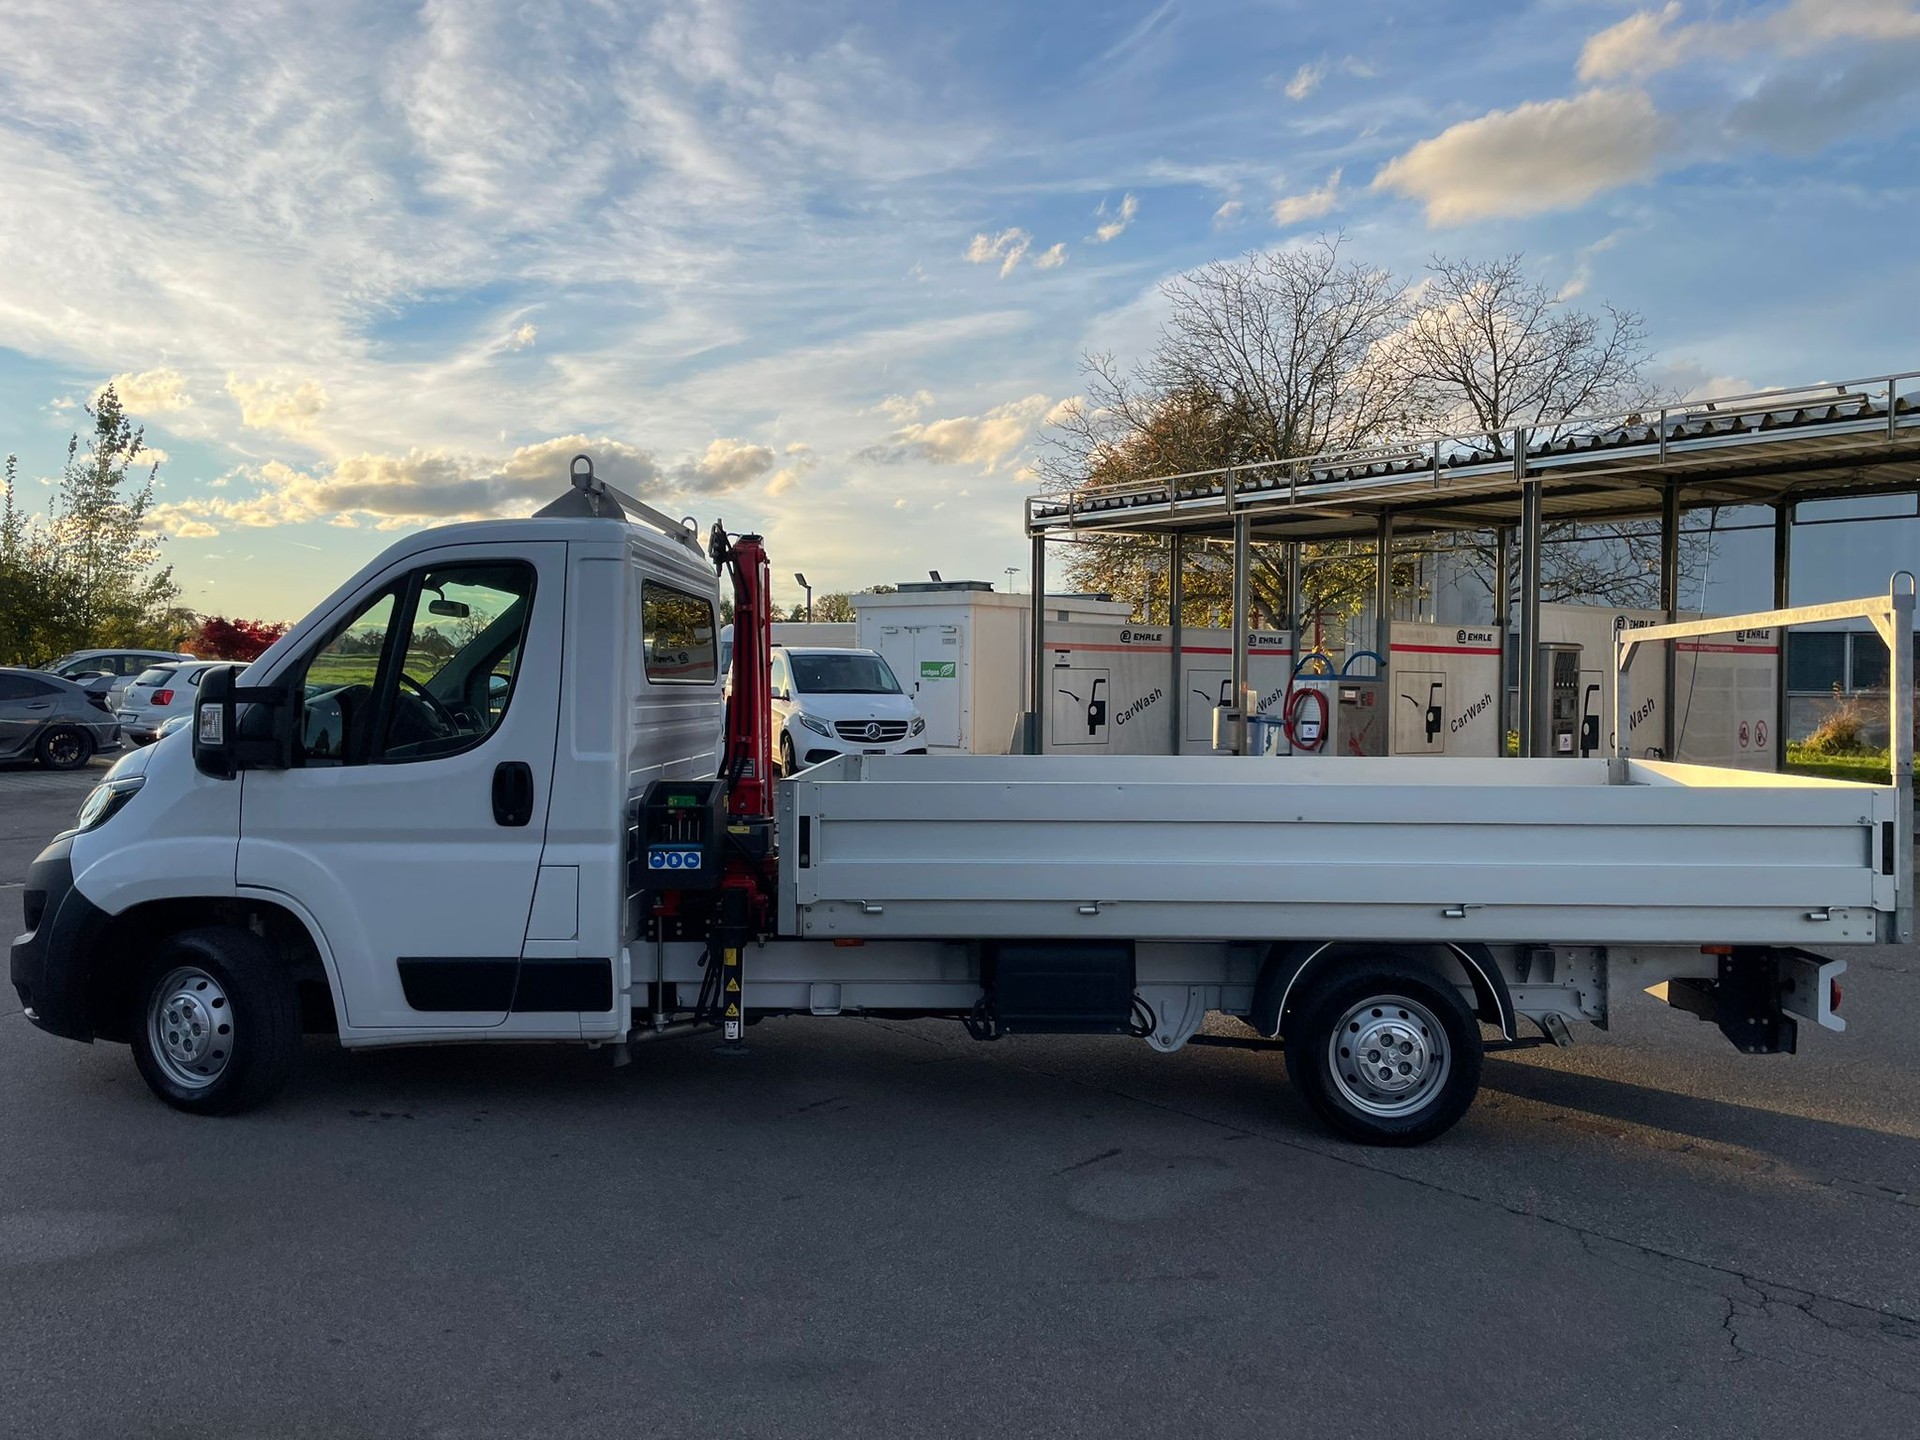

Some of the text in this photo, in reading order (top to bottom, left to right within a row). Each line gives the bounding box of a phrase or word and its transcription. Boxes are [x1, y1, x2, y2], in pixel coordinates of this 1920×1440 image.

[1133, 633, 1162, 641] EHRLE
[1467, 633, 1493, 641] EHRLE
[1746, 629, 1770, 639] EHRLE
[1258, 637, 1283, 645] EHRLE
[1257, 688, 1283, 712] Wash
[1115, 687, 1162, 726] CarWash
[1450, 693, 1492, 733] CarWash
